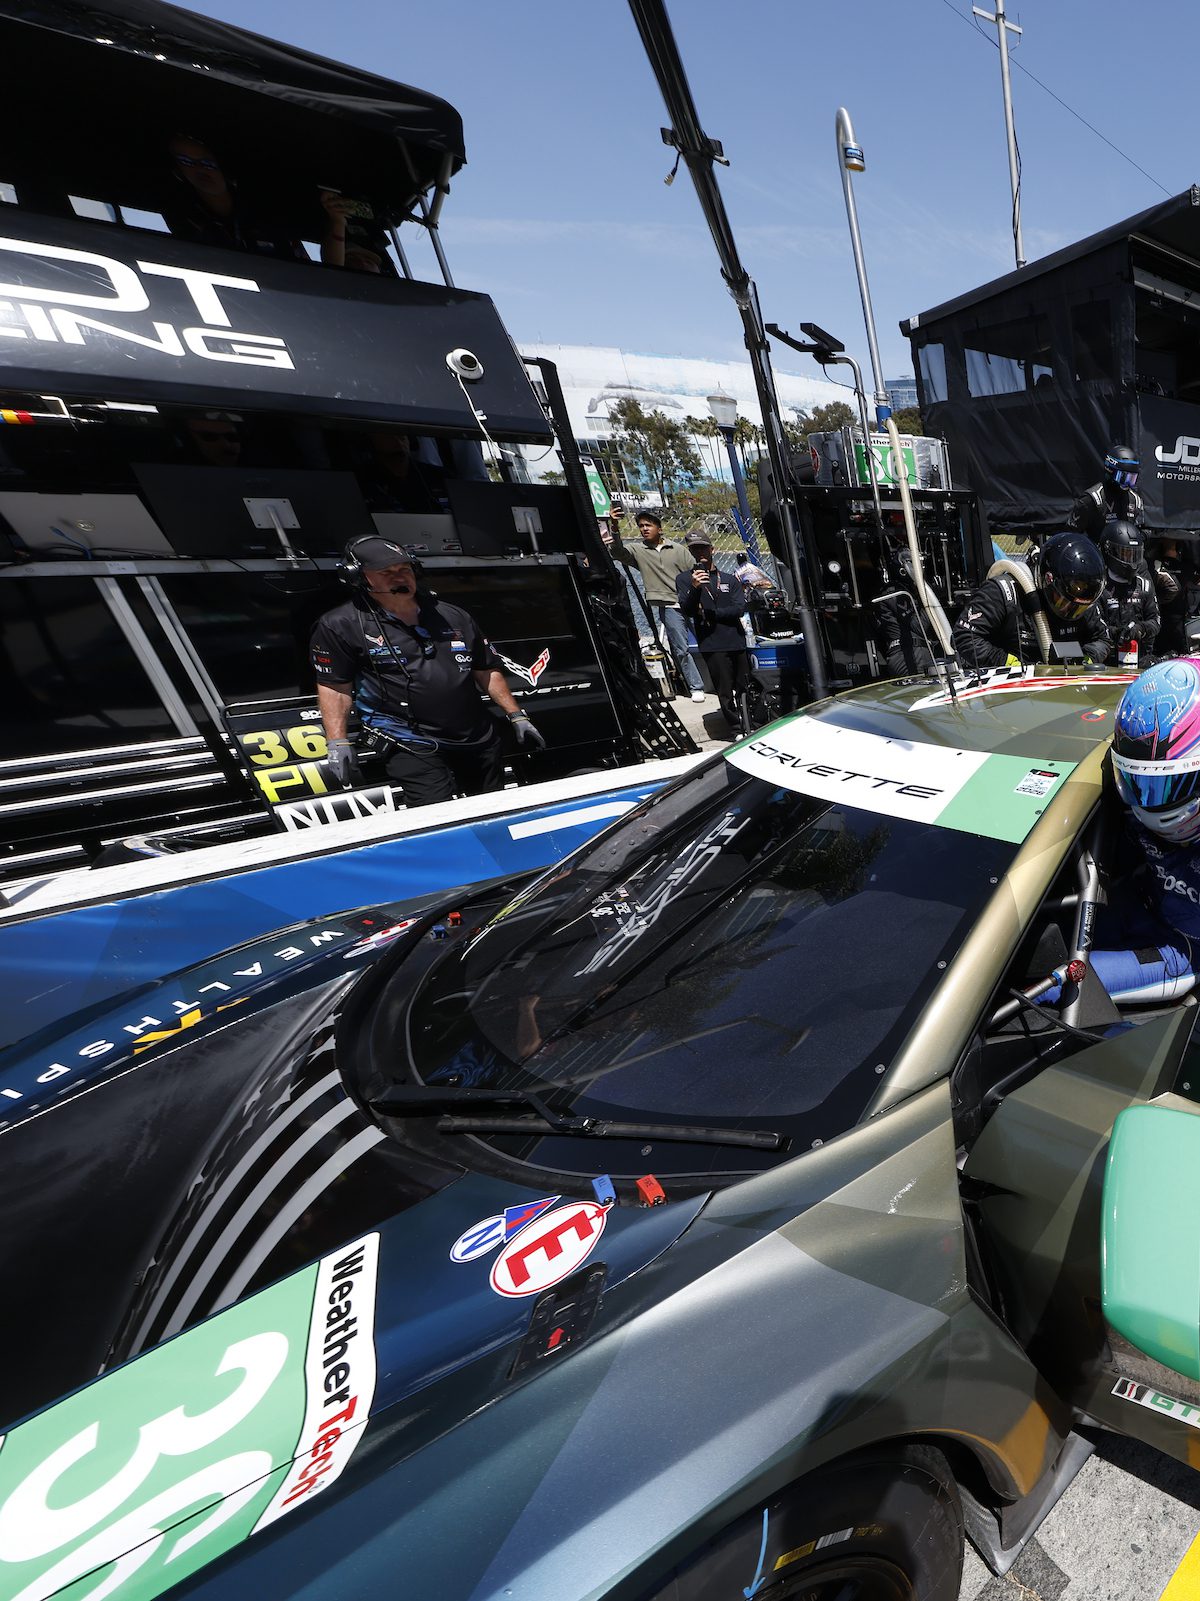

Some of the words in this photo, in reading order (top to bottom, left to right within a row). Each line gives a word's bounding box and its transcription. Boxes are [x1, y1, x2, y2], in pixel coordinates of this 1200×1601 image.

[855, 438, 910, 448] Watherch
[1178, 465, 1200, 474] MILLER
[589, 482, 607, 506] 6
[481, 682, 592, 701] CRVETTE
[243, 725, 329, 765] 36
[254, 760, 335, 803] PI
[749, 742, 944, 799] CORVETTE
[274, 786, 395, 832] NOW
[0, 929, 344, 1100] WEALTHSPI
[461, 1219, 503, 1258] N
[505, 1208, 595, 1289] E
[281, 1244, 367, 1508] WeatherTech
